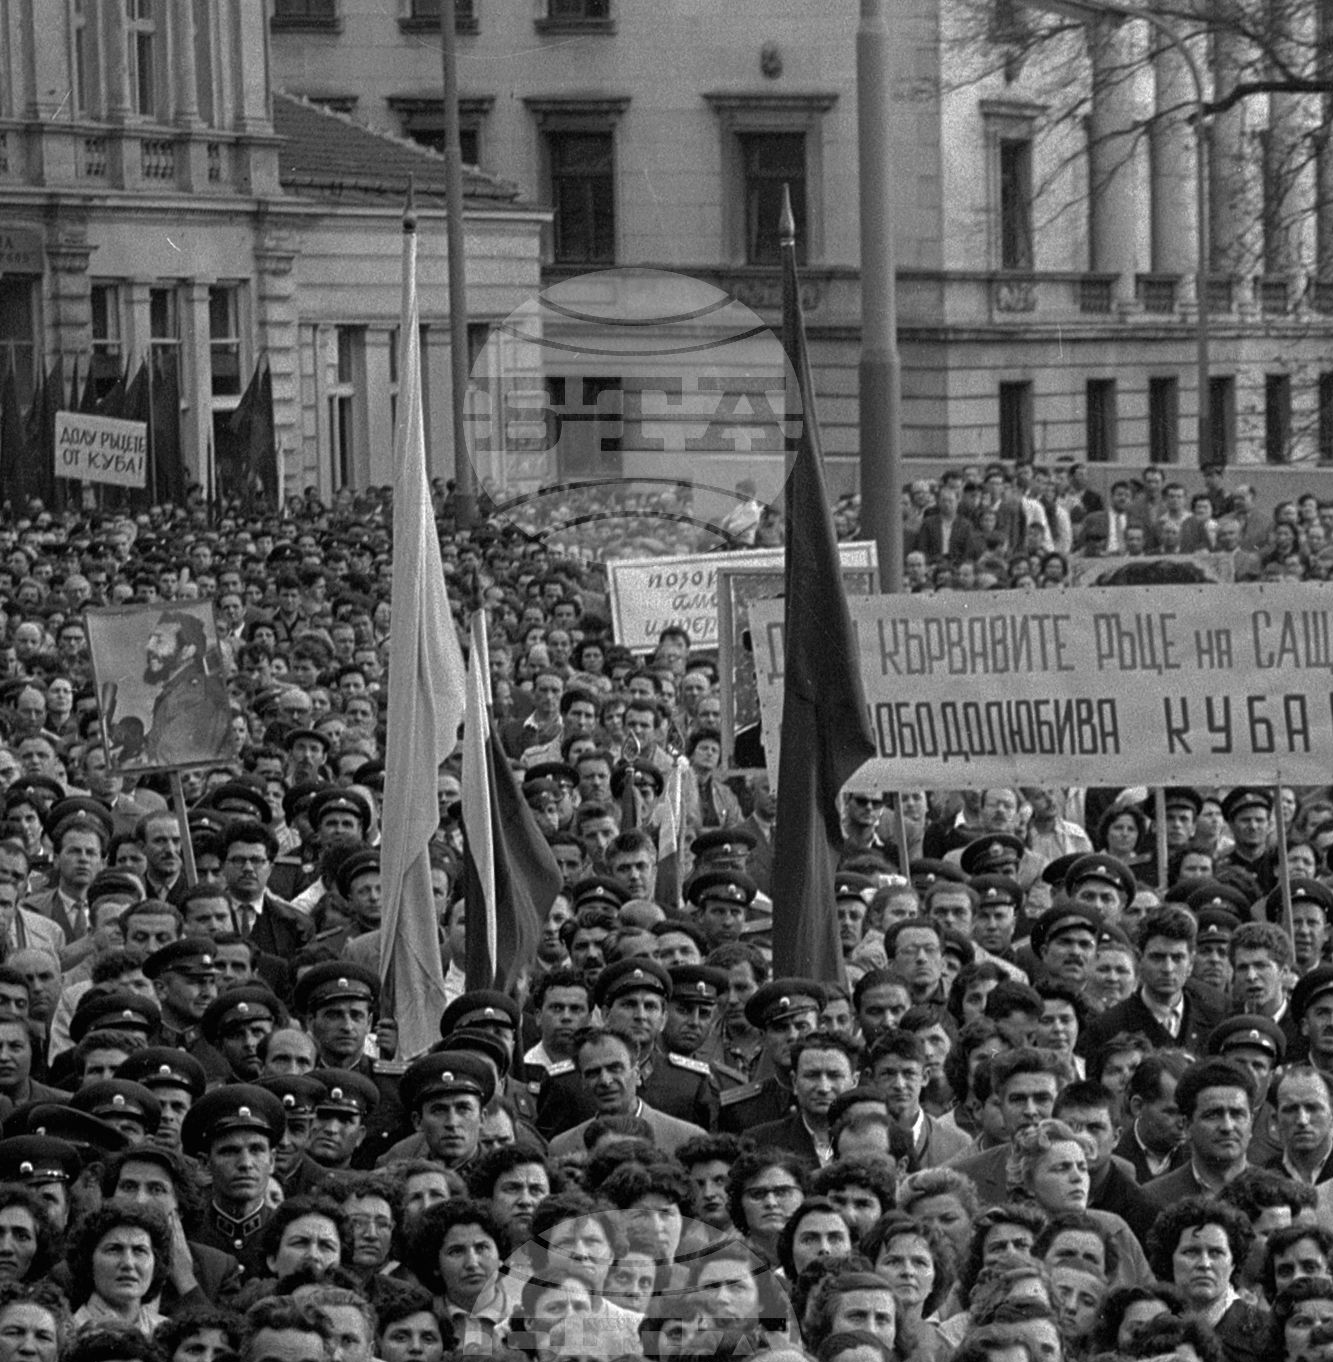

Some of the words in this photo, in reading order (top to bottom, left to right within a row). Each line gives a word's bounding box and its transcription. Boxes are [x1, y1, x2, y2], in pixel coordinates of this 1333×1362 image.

[60, 426, 97, 446] ДОЛУ
[63, 448, 80, 465] ОТ
[88, 451, 143, 473] КУБА!
[877, 614, 1075, 675] КЪРВАВИТЕ
[1094, 613, 1181, 675] РЪЦЕ
[868, 698, 1120, 762] ОБОДОЛЮБИВА
